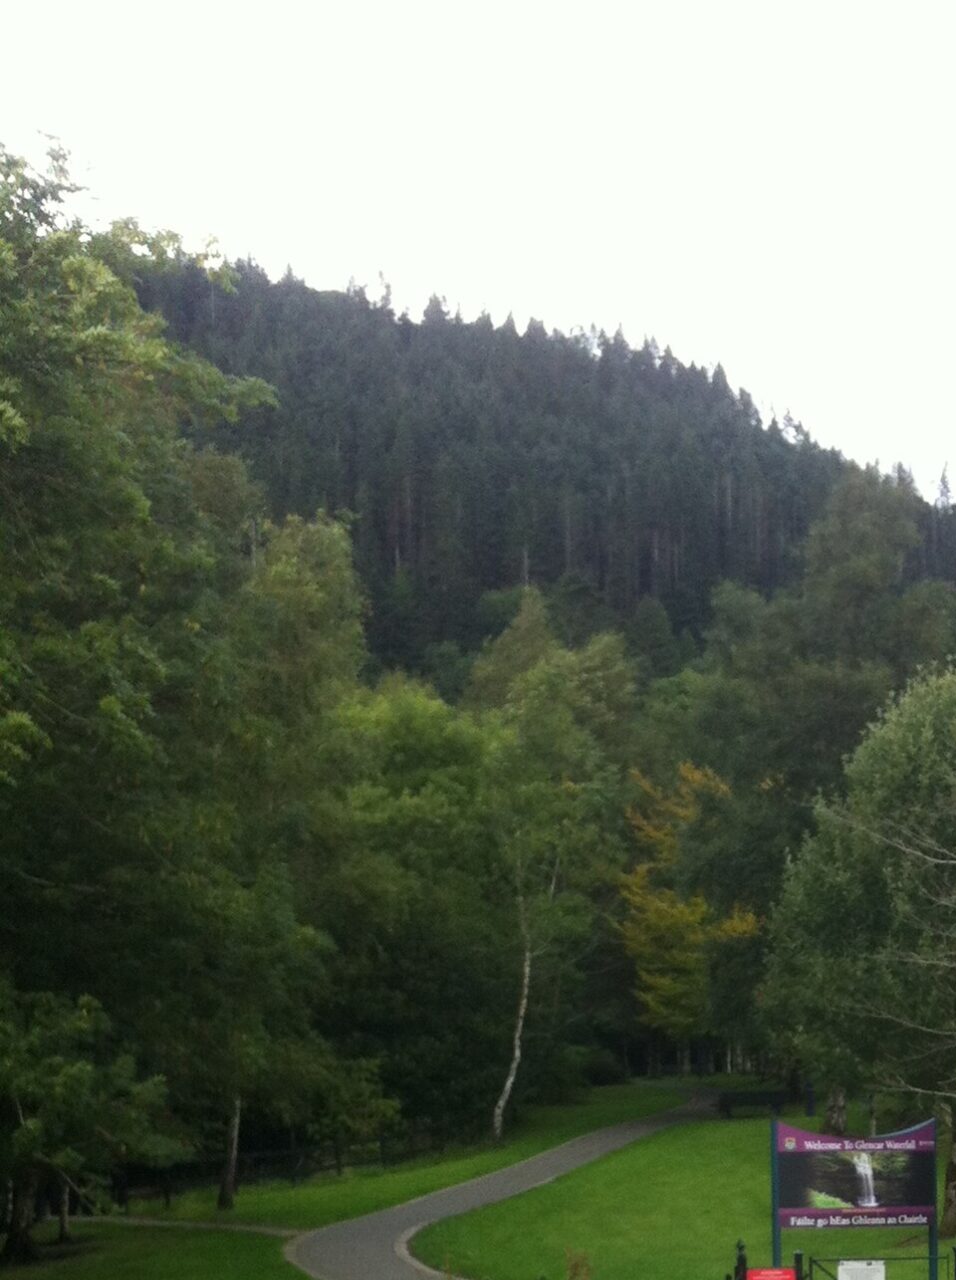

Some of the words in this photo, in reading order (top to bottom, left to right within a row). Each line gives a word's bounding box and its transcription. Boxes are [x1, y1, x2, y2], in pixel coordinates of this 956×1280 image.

[804, 1140, 842, 1150] Welcome
[844, 1140, 854, 1150] To
[855, 1140, 885, 1150] Glencar
[885, 1139, 916, 1150] Waterfall
[817, 1218, 829, 1228] go
